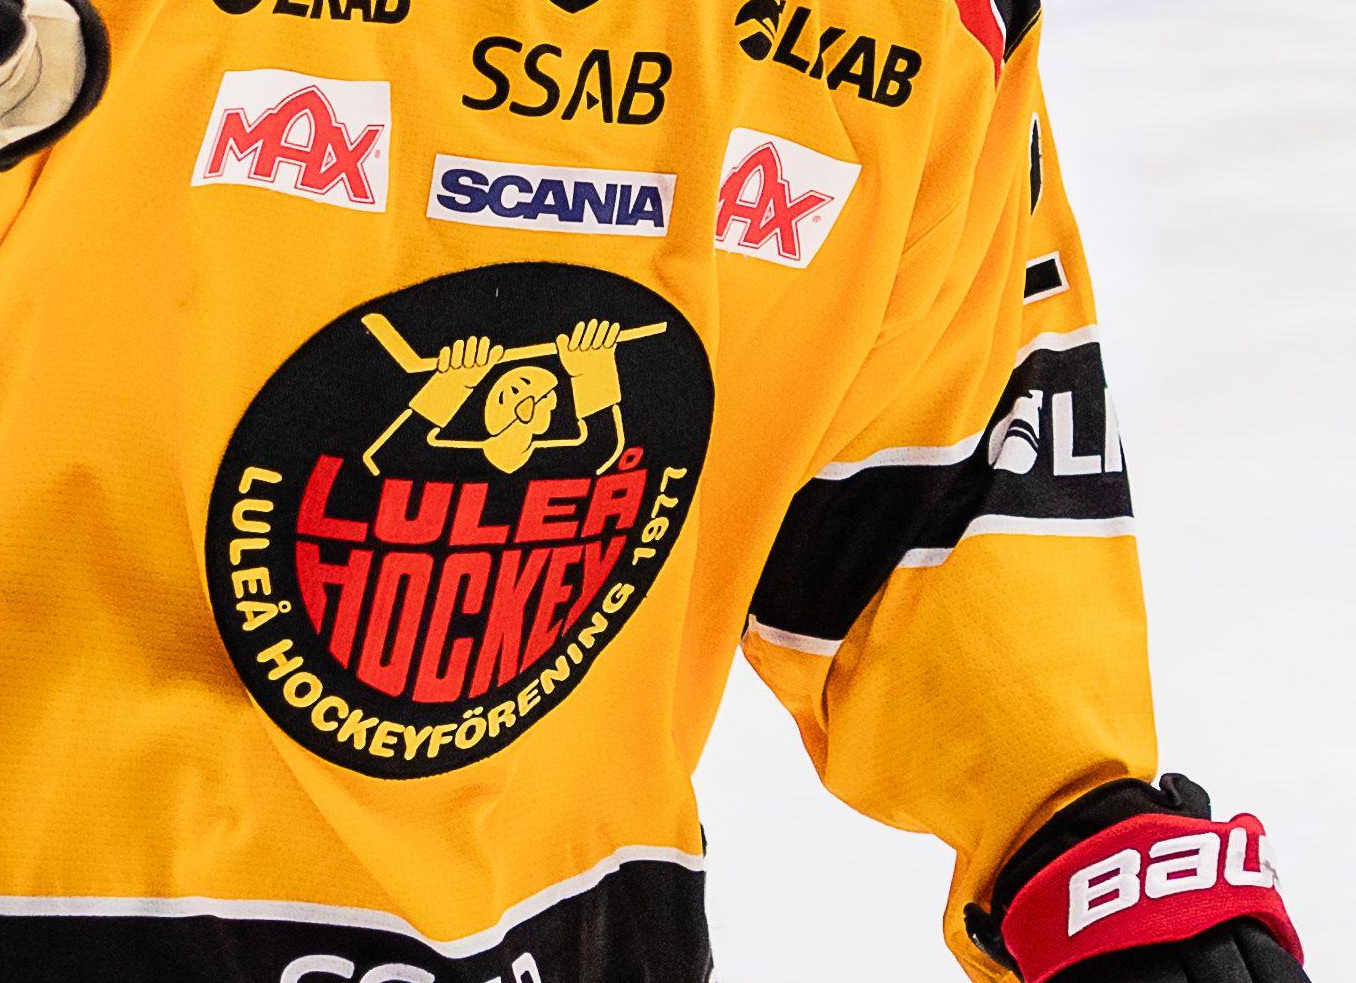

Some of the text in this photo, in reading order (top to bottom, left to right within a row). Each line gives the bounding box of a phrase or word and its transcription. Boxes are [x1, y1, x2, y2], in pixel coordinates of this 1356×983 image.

[461, 35, 673, 125] SSAB
[772, 5, 923, 108] LKAB
[203, 85, 385, 205] MAX
[436, 168, 665, 228] SCANIA
[297, 447, 648, 547] LULEÅ
[228, 466, 688, 762] LULEÅ HOCKEYFÖRENING 1977
[295, 535, 627, 705] HOCKEY
